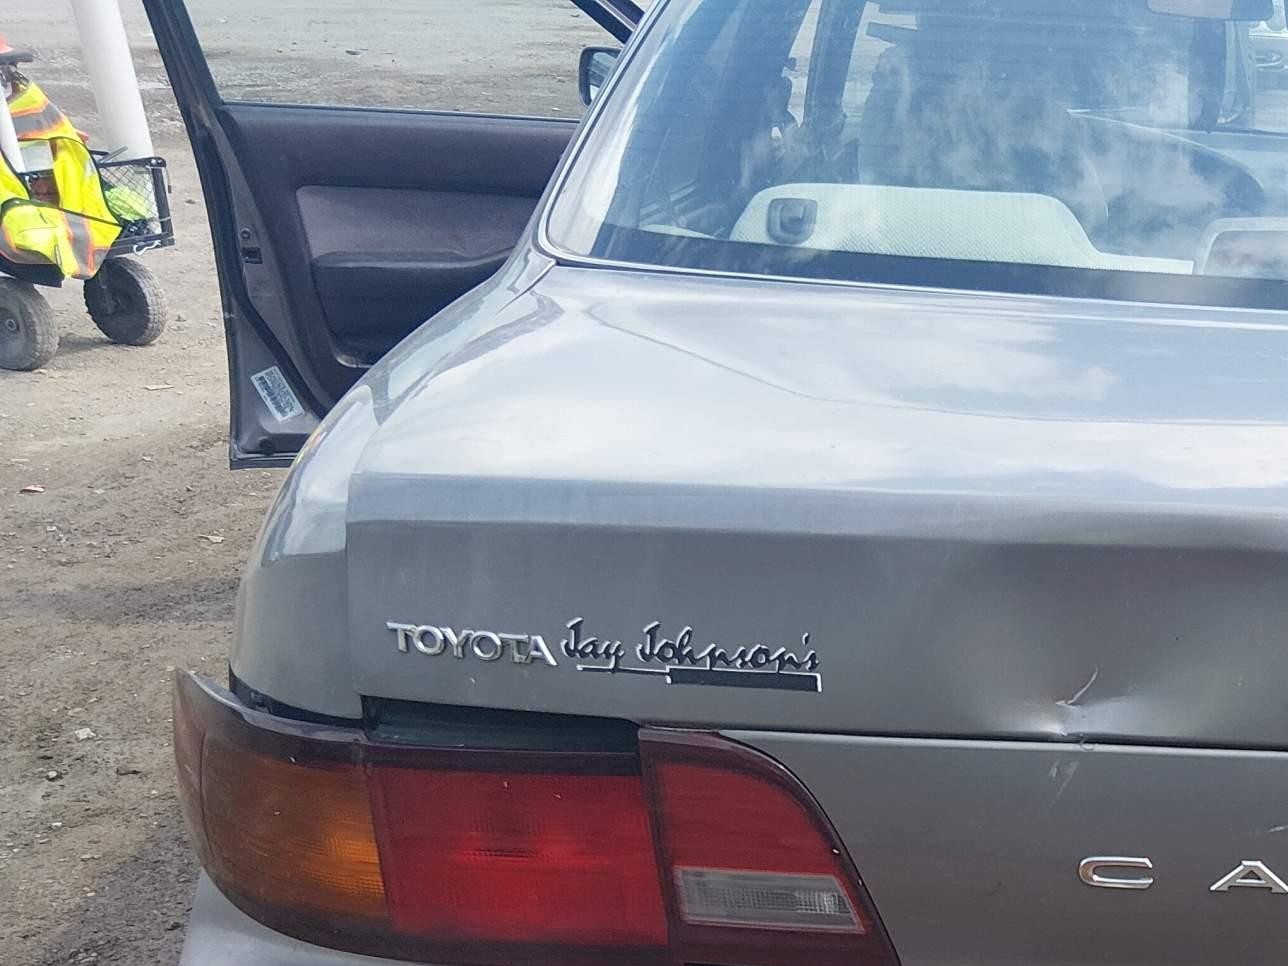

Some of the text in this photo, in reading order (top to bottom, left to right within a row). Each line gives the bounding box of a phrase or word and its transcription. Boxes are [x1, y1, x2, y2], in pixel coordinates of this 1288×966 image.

[386, 621, 559, 667] TOYOTA
[560, 617, 819, 674] Jay Johnson's
